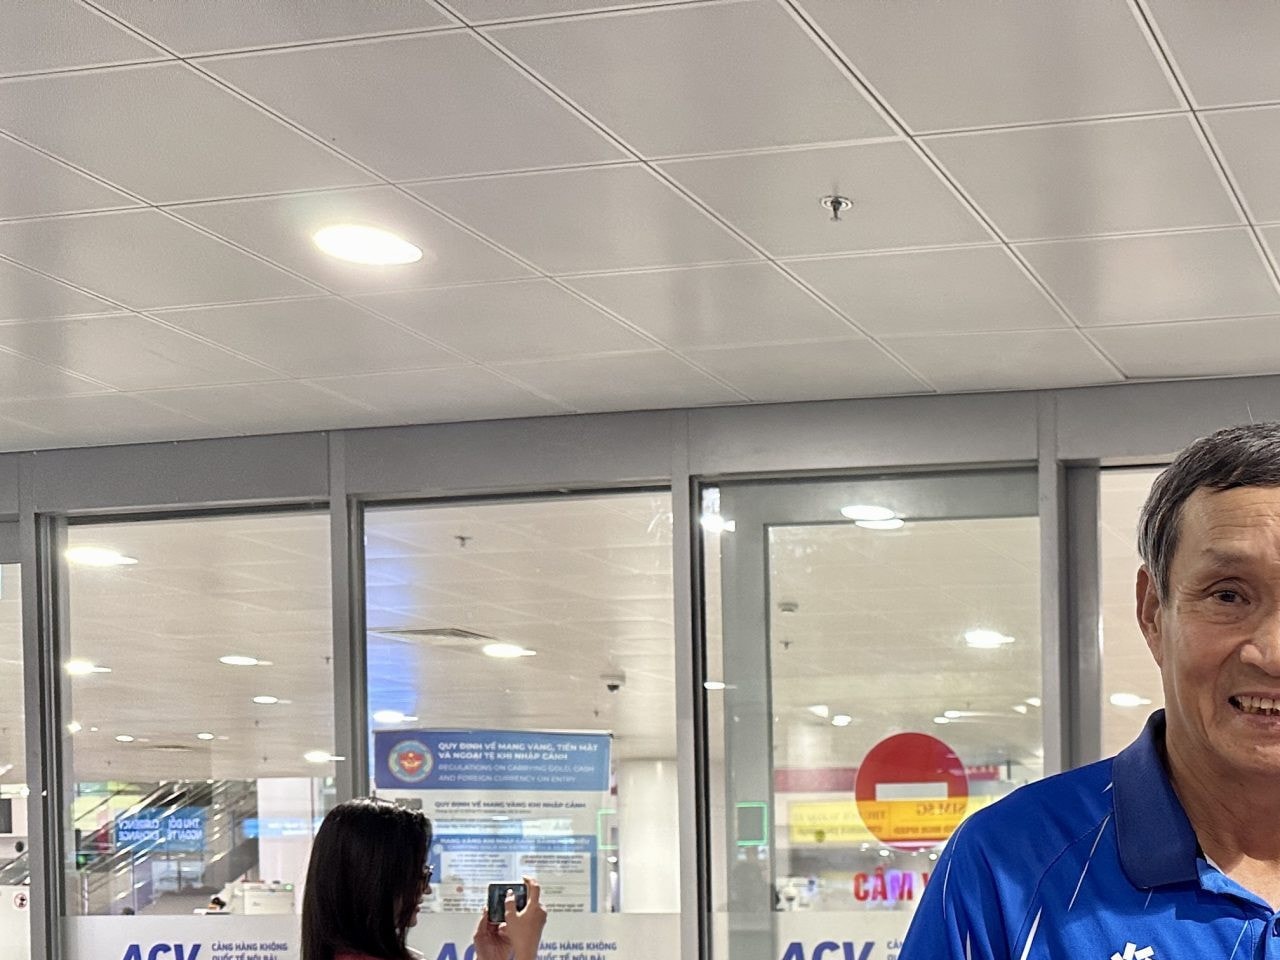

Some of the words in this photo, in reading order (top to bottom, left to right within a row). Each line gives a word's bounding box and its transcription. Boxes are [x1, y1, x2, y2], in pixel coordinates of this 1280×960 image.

[438, 742, 458, 750] QUY
[498, 742, 525, 751] MANG
[211, 940, 233, 951] CẢNG
[235, 940, 257, 951] HÀNG
[260, 941, 288, 951] KHÔNG
[540, 941, 557, 950] ẢNG
[560, 941, 584, 950] HÀNG
[586, 941, 617, 950] KHÔNG
